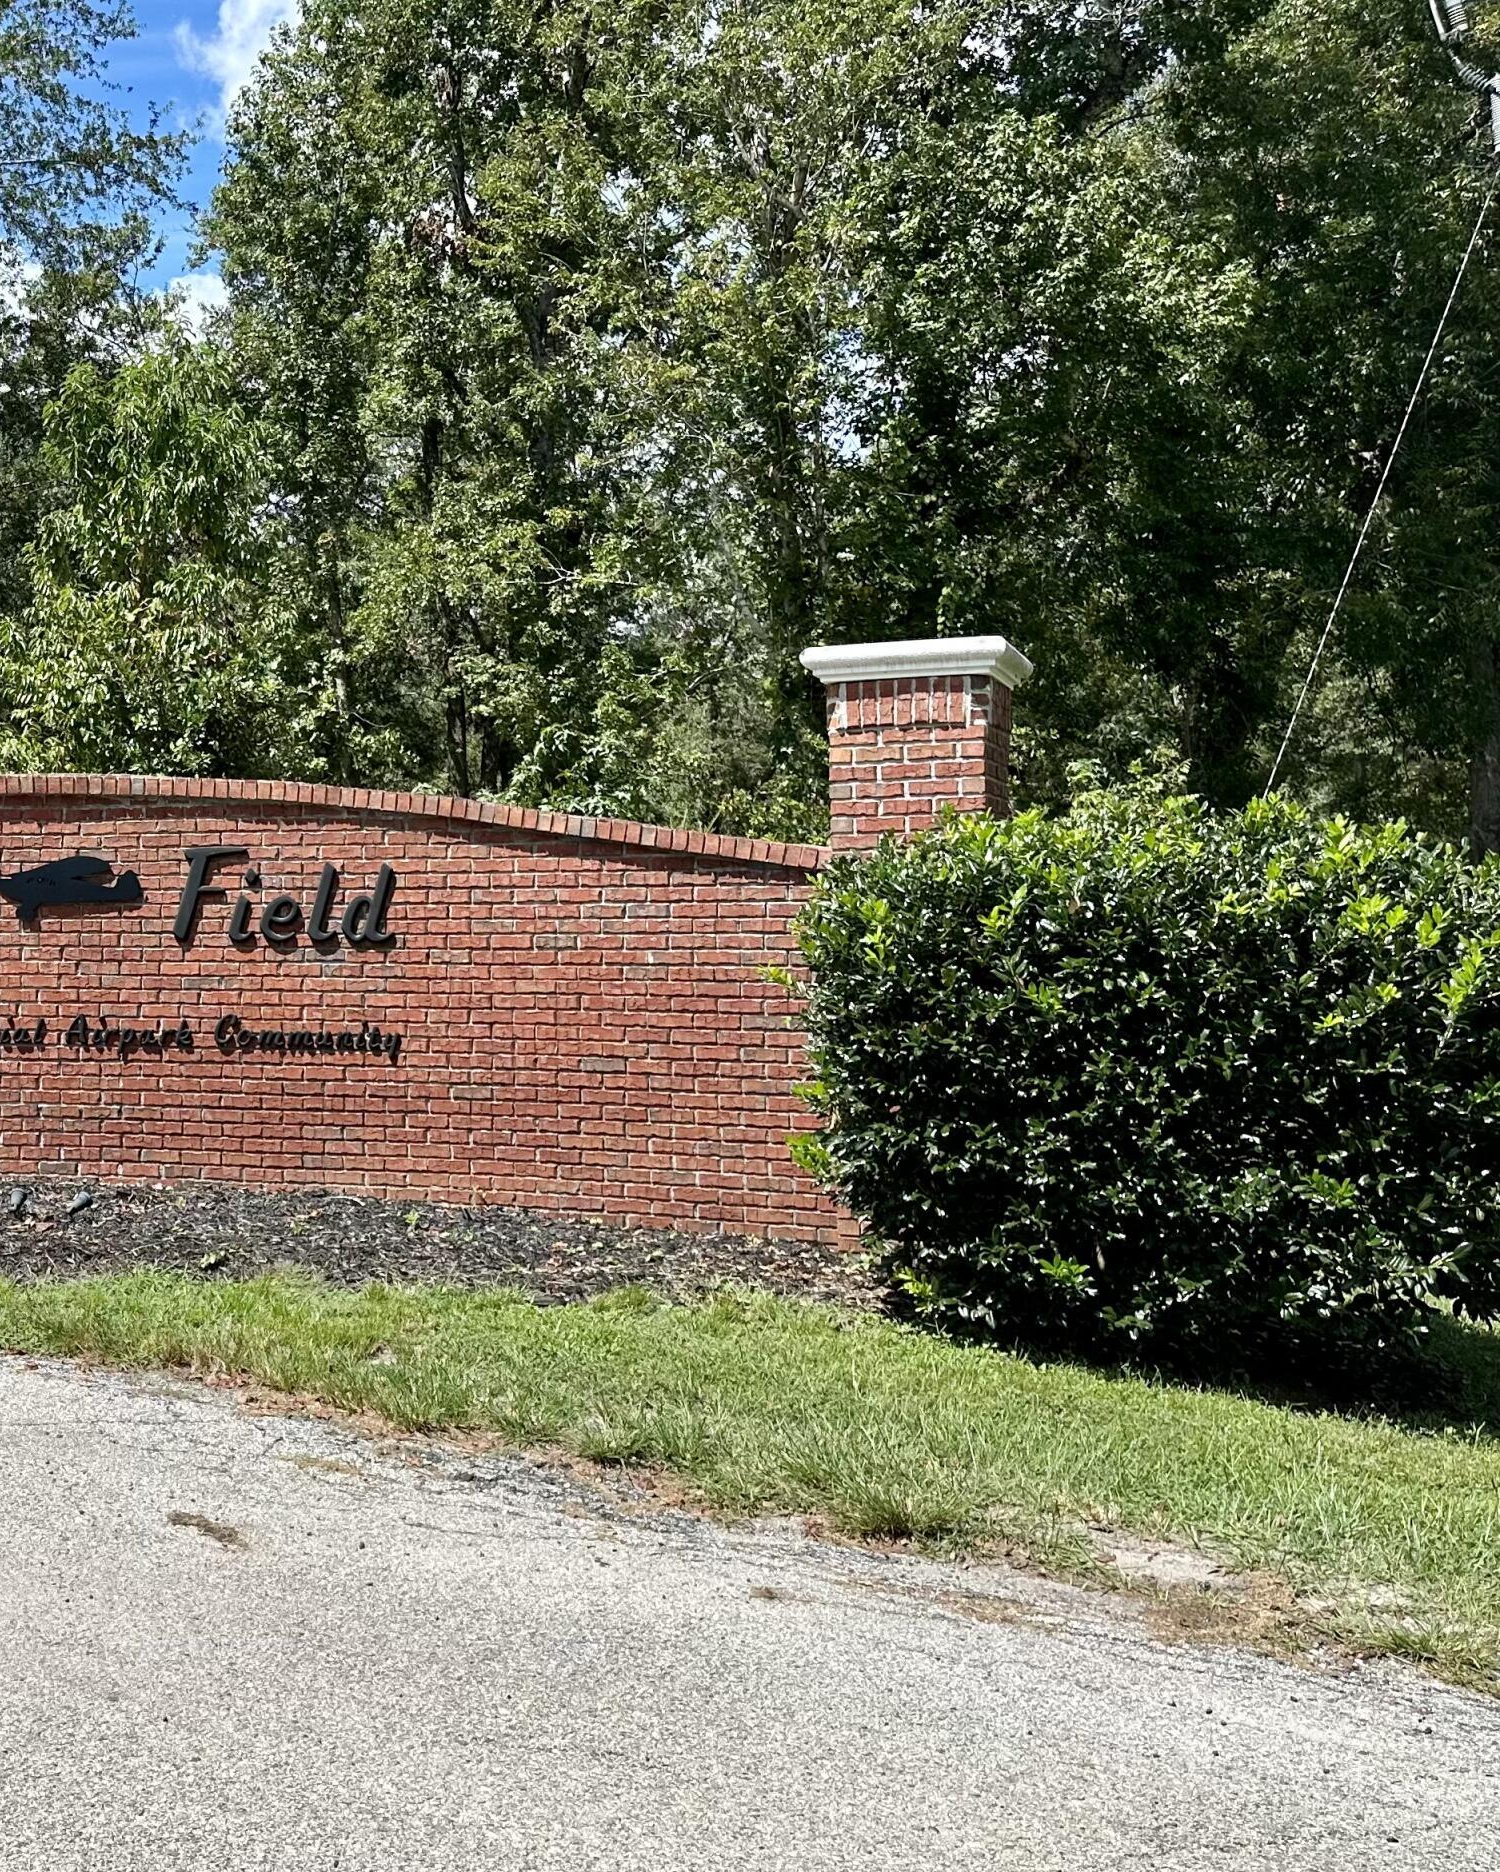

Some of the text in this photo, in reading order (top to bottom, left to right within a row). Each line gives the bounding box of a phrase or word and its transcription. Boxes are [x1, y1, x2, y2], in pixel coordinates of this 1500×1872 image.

[171, 846, 394, 942] Field
[66, 1013, 194, 1058] Airpark
[214, 1013, 402, 1062] Community
